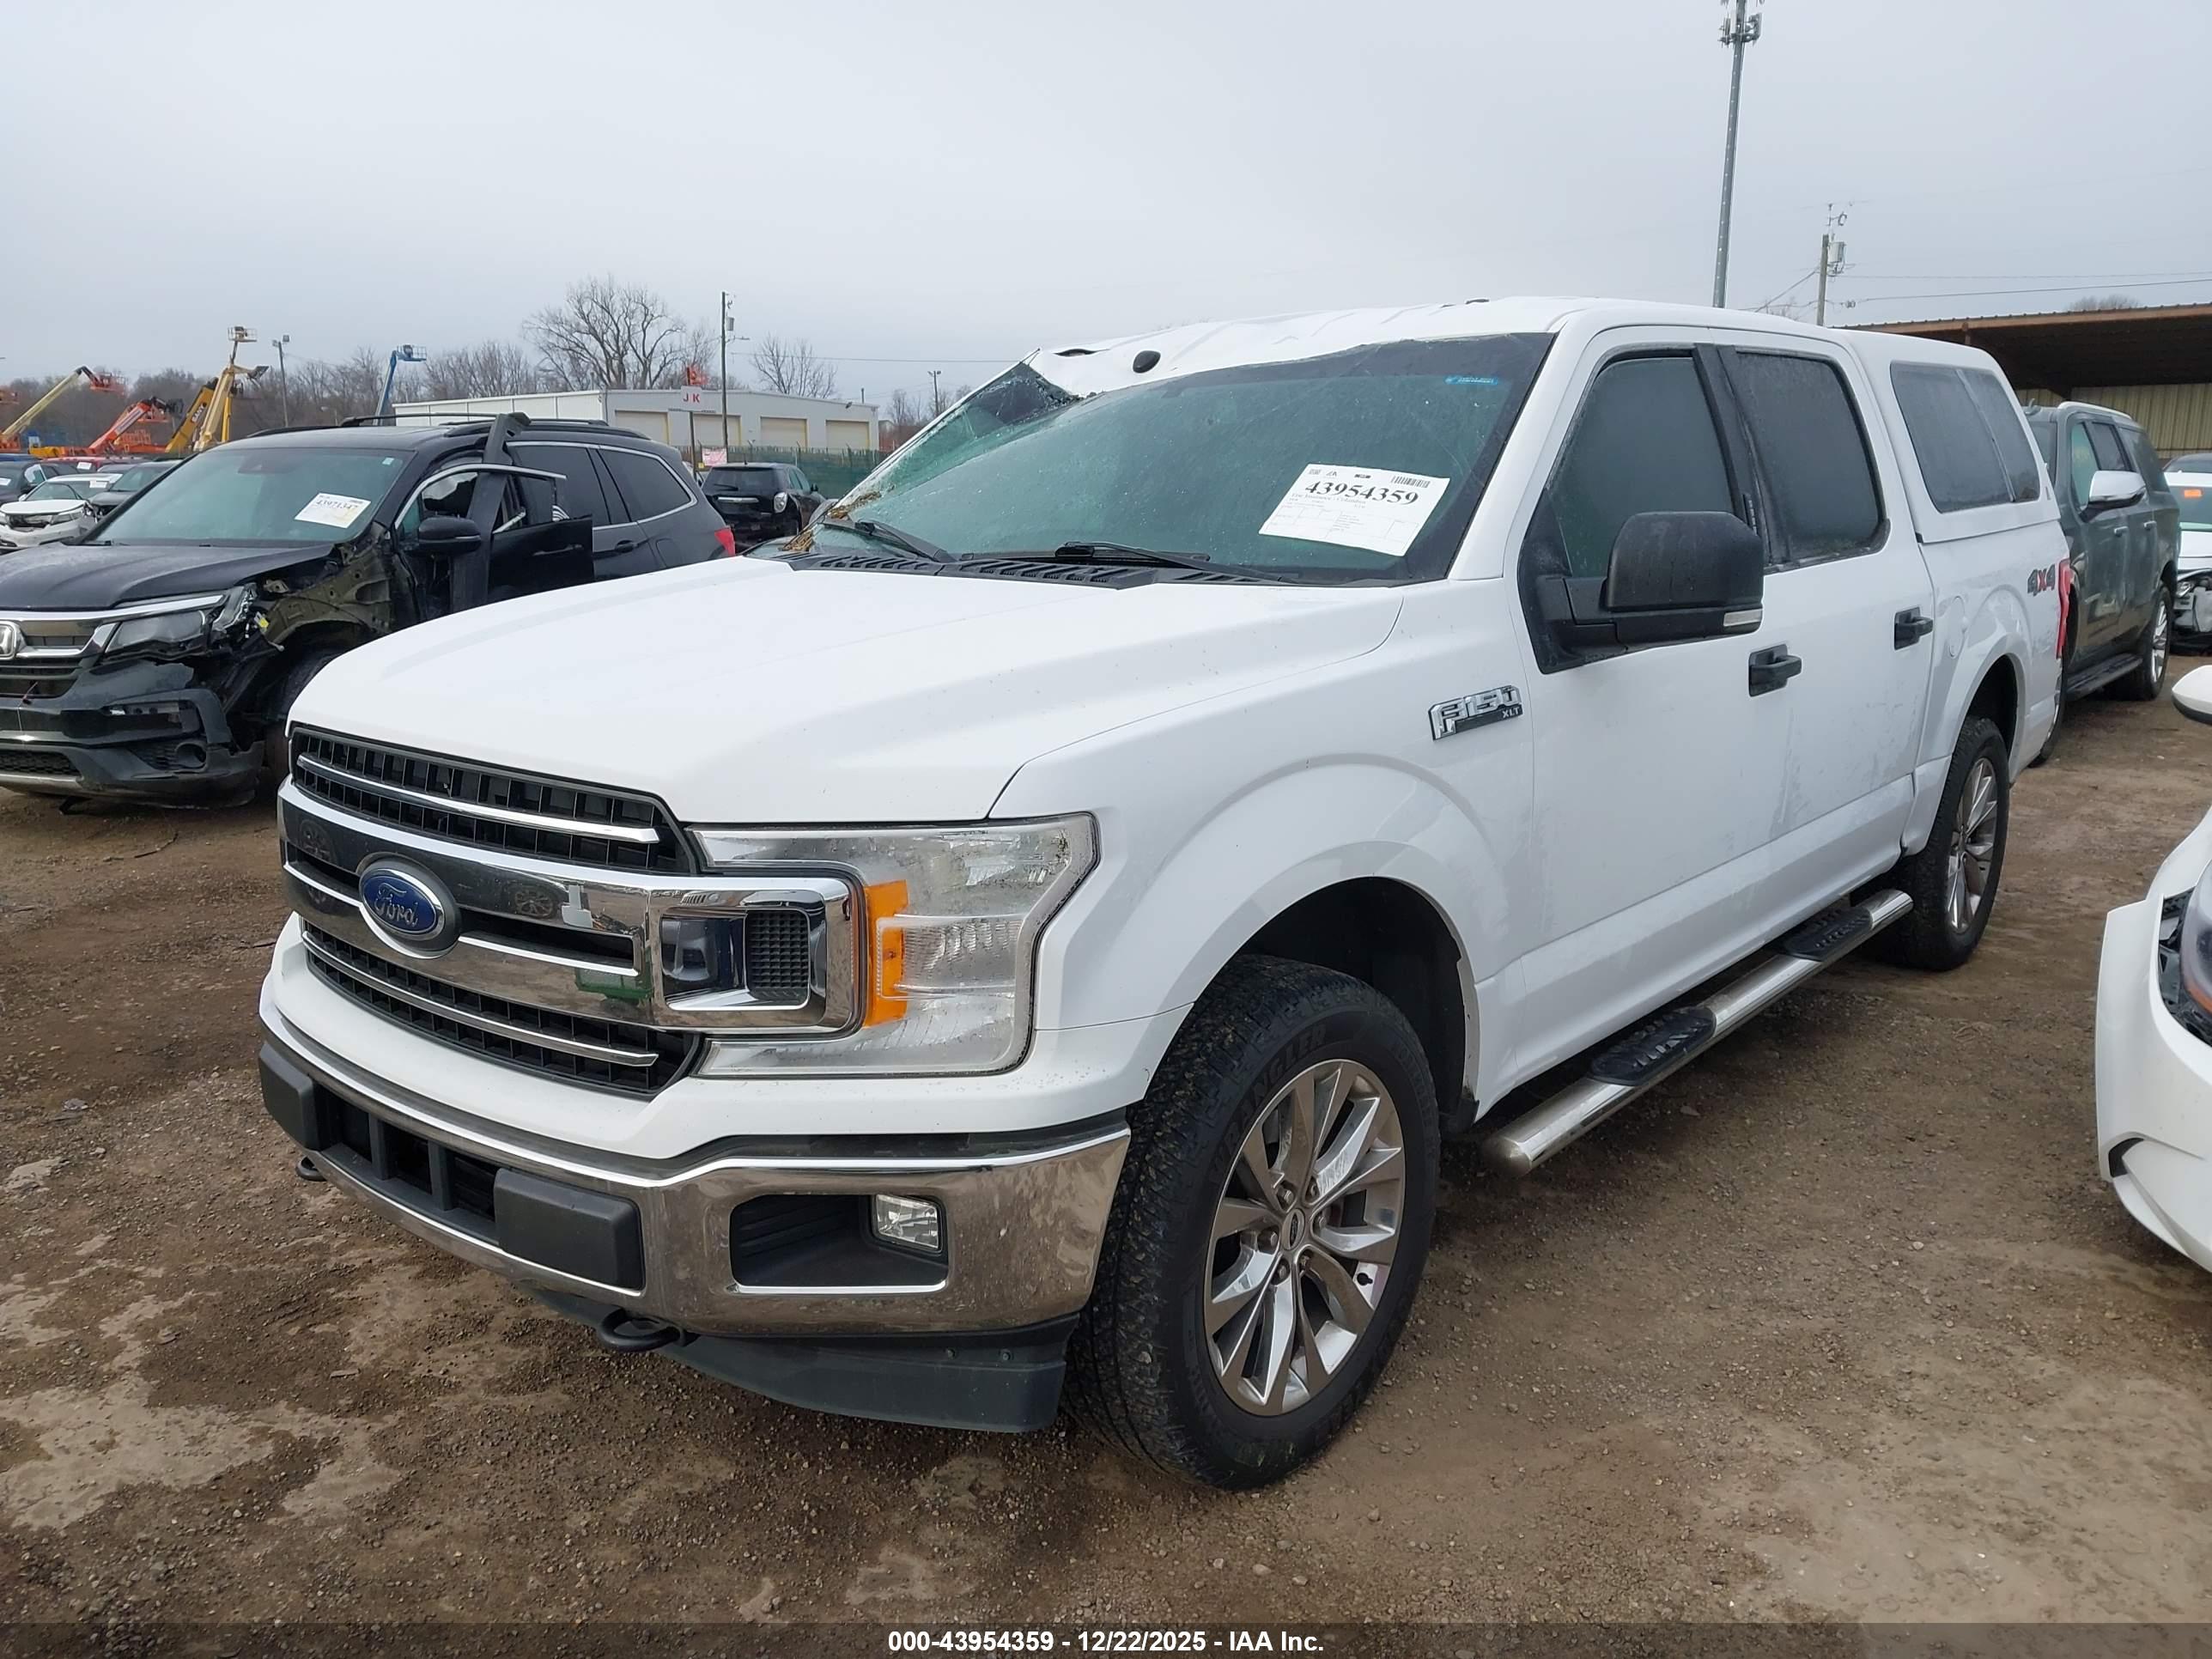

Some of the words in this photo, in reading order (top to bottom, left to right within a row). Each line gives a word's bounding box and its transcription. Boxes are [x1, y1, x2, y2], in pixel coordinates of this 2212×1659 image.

[1304, 480, 1419, 506] 43954359
[1502, 706, 1521, 719] XLT
[374, 883, 418, 927] Ford
